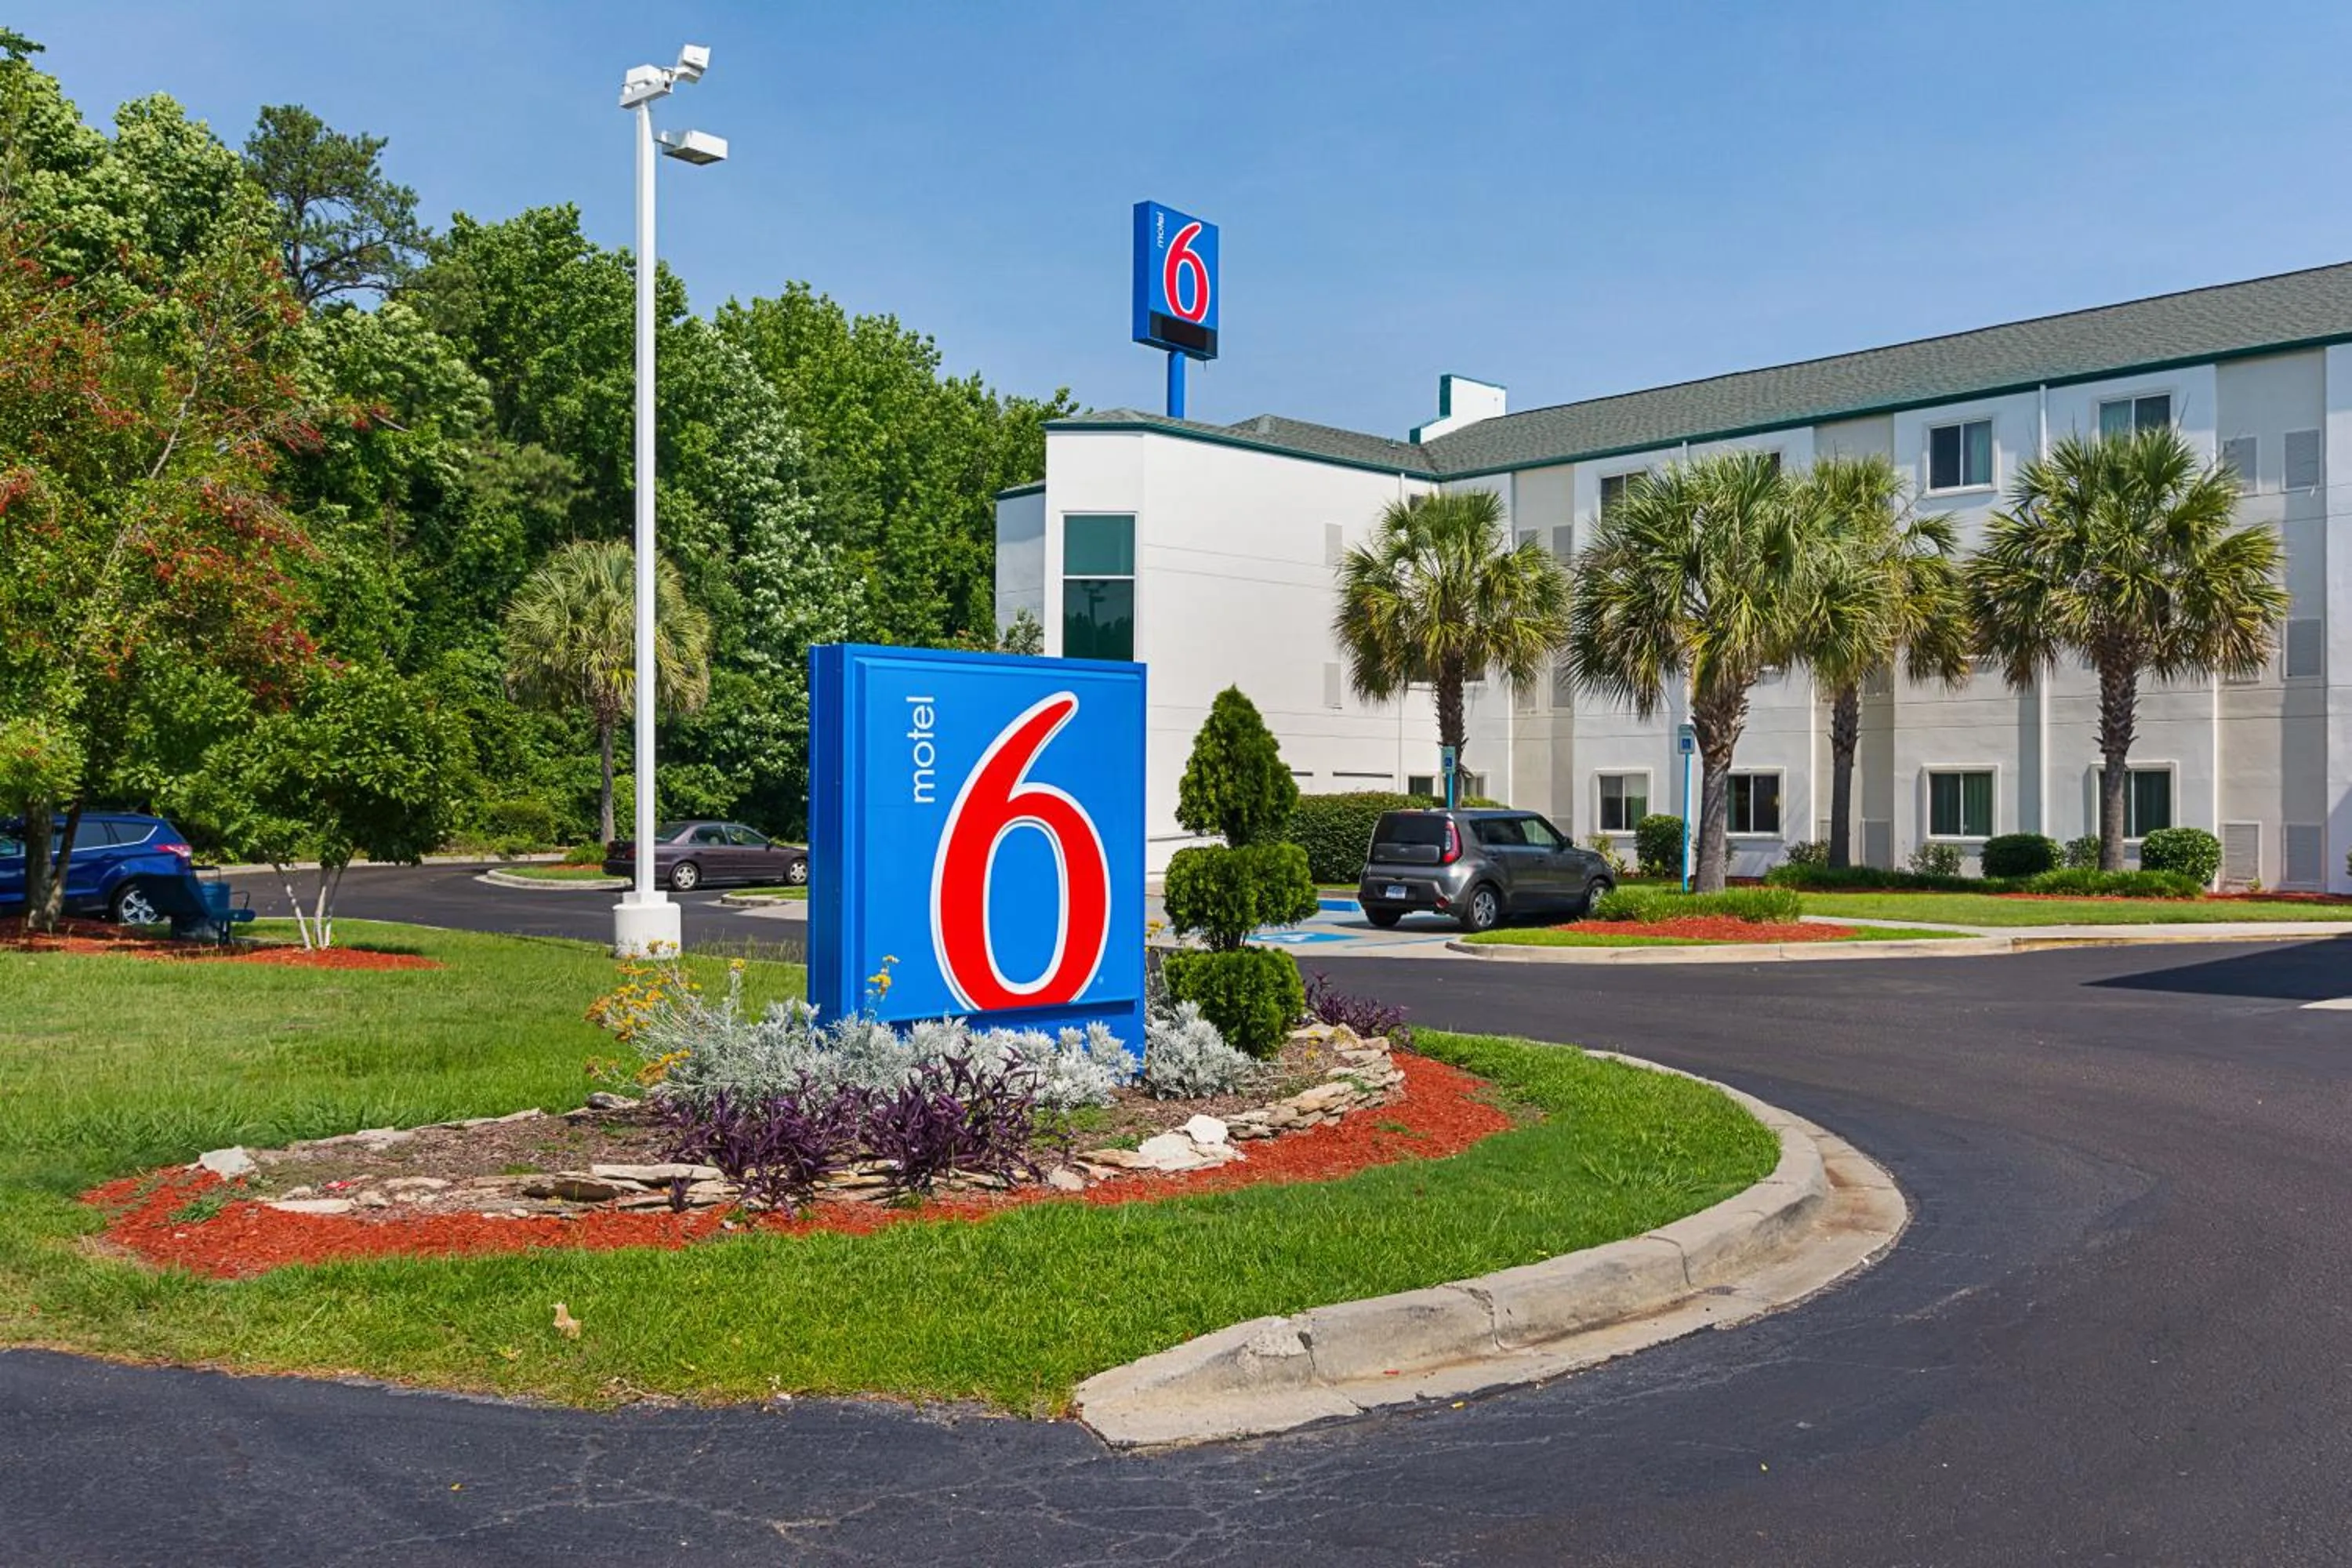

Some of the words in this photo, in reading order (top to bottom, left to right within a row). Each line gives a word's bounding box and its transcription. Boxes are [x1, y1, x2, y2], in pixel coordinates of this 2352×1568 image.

[1164, 221, 1210, 323] 6
[906, 696, 935, 804] motel
[931, 691, 1111, 1011] 6
